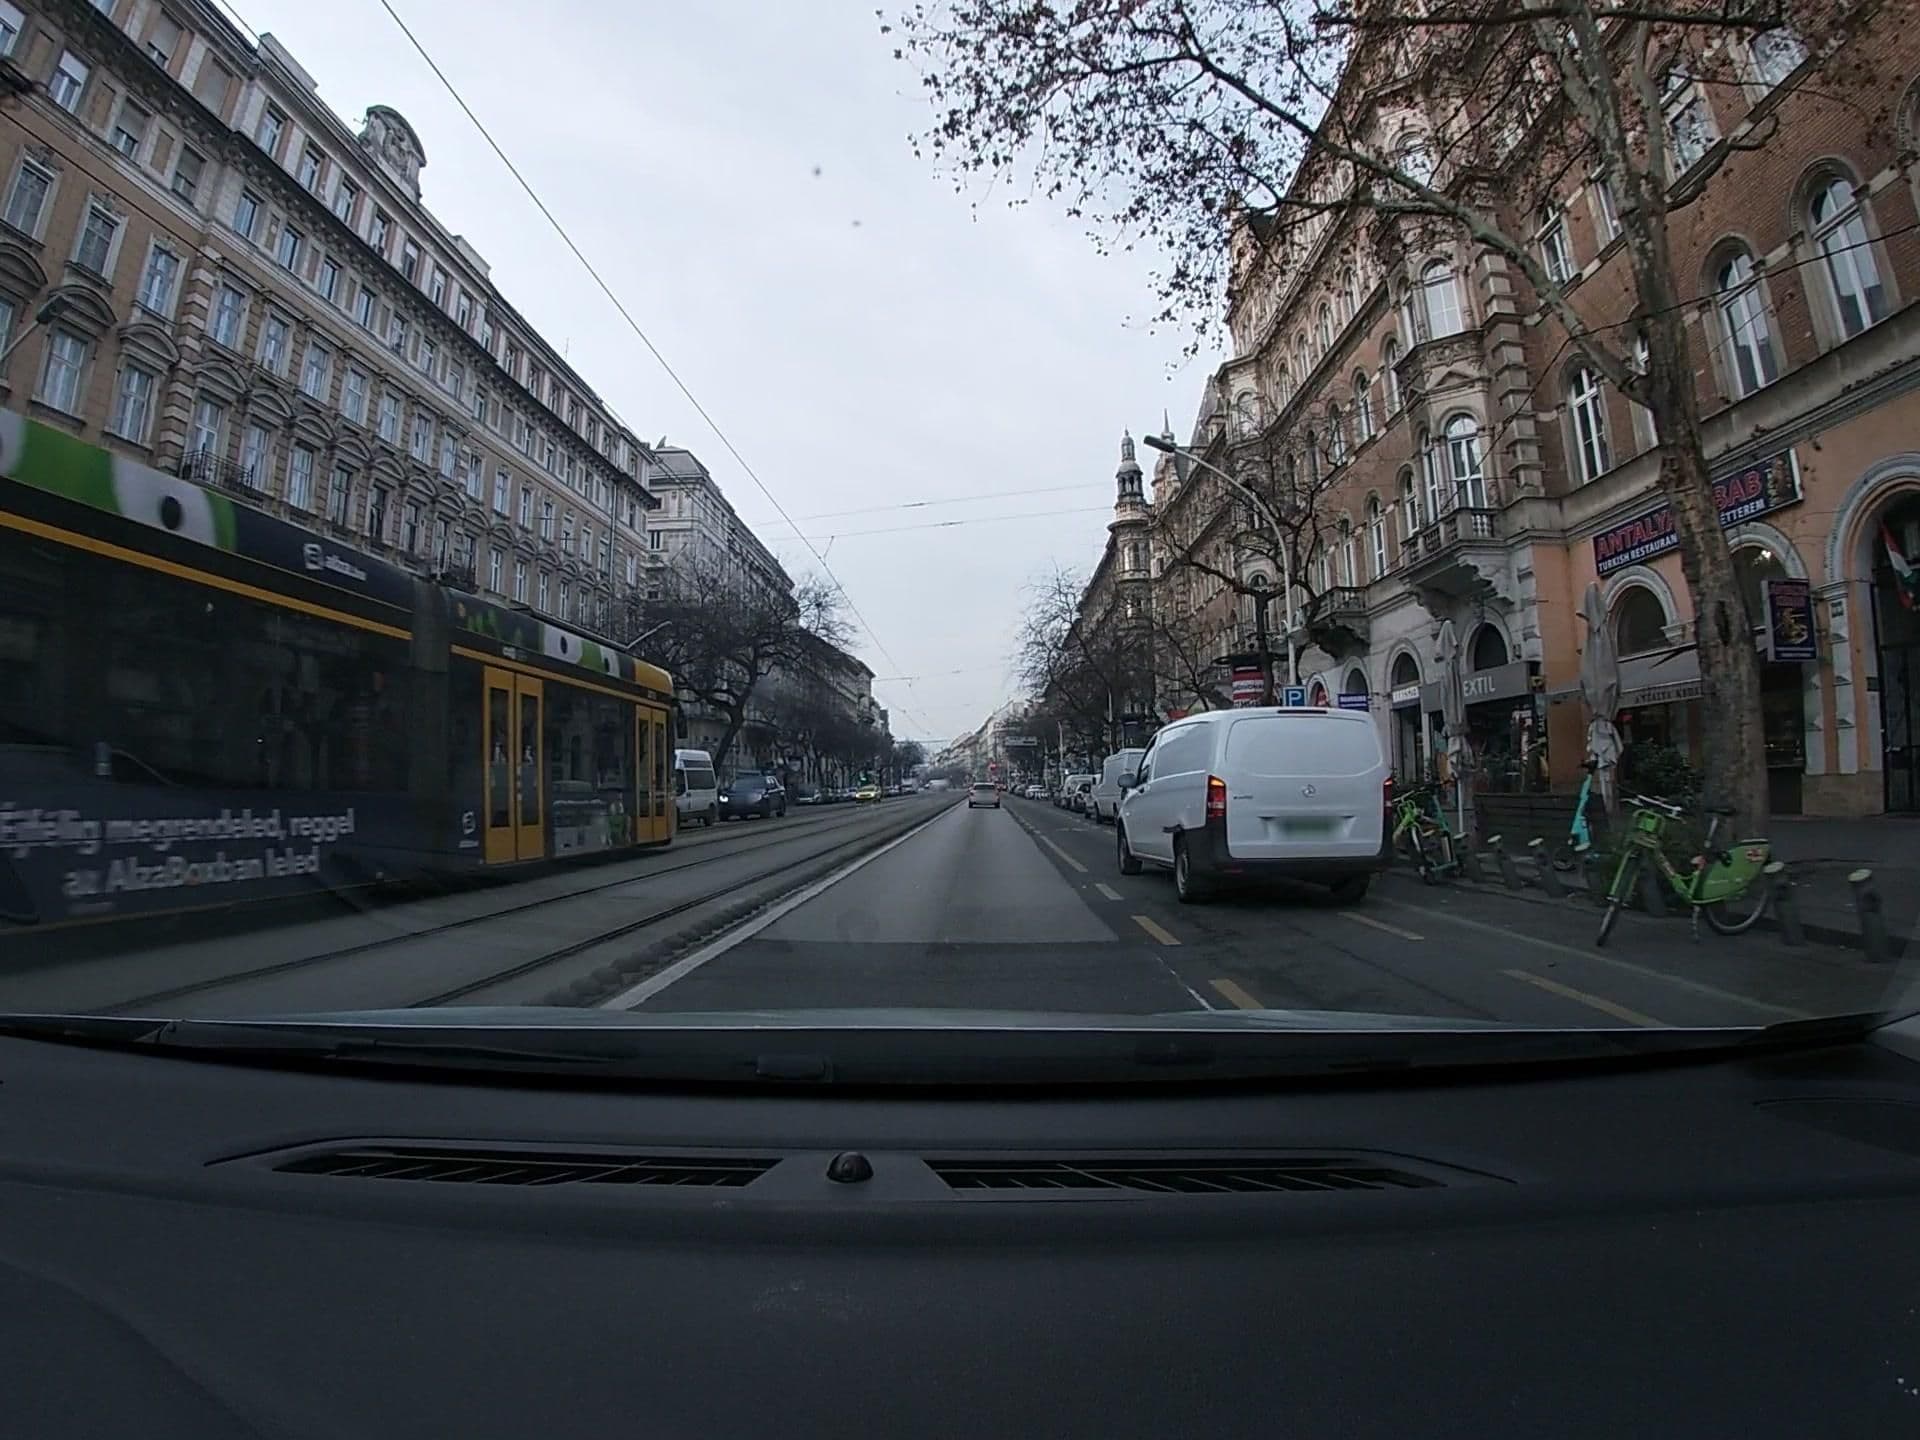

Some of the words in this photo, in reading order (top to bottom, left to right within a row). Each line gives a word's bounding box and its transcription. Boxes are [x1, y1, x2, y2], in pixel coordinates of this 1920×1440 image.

[1711, 470, 1762, 511] BAB
[1598, 552, 1631, 572] TURKISH
[1630, 533, 1678, 561] RESTAURAN
[1288, 690, 1302, 707] P
[1463, 675, 1496, 698] EXTIL
[289, 807, 355, 843] reggel
[264, 845, 320, 878] leled
